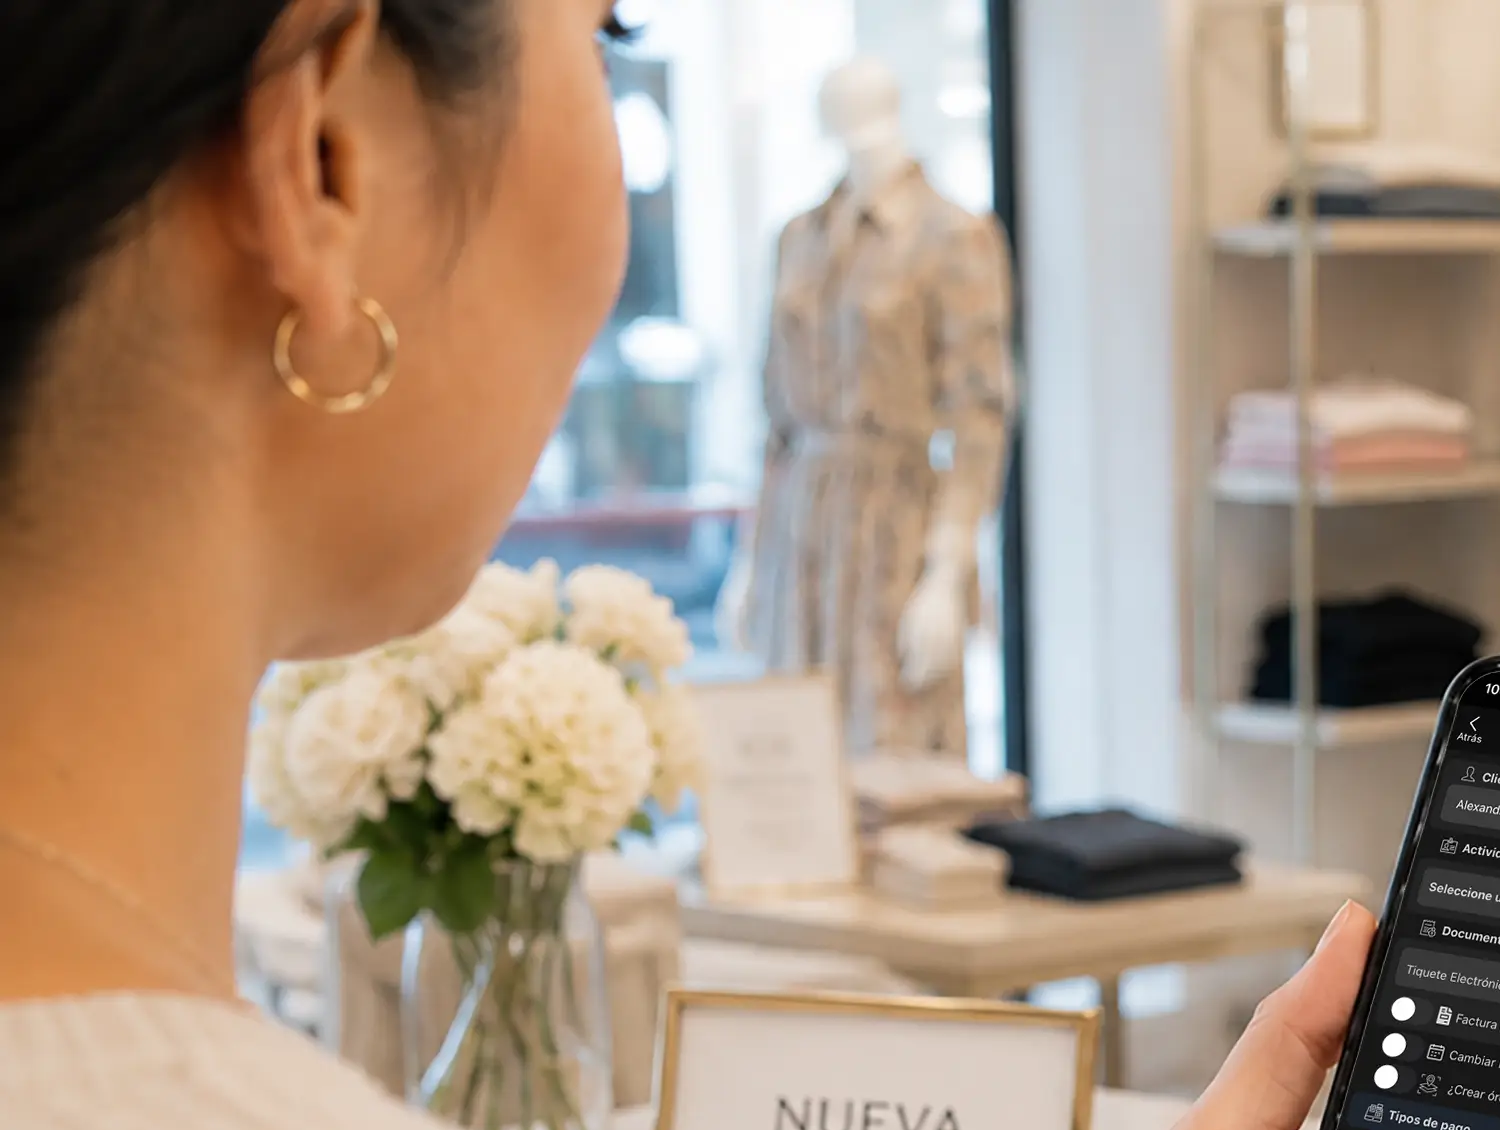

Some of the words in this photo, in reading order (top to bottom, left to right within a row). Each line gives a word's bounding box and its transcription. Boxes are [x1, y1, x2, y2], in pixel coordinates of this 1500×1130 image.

[1457, 731, 1482, 744] Atrás
[1428, 881, 1492, 901] Seleccione
[1406, 965, 1447, 984] Tiquete
[1455, 1012, 1497, 1031] Factura
[1449, 1049, 1495, 1068] Cambiar
[1447, 1084, 1485, 1100] ¿Crear
[1389, 1109, 1420, 1125] Tipos
[1423, 1116, 1438, 1129] de
